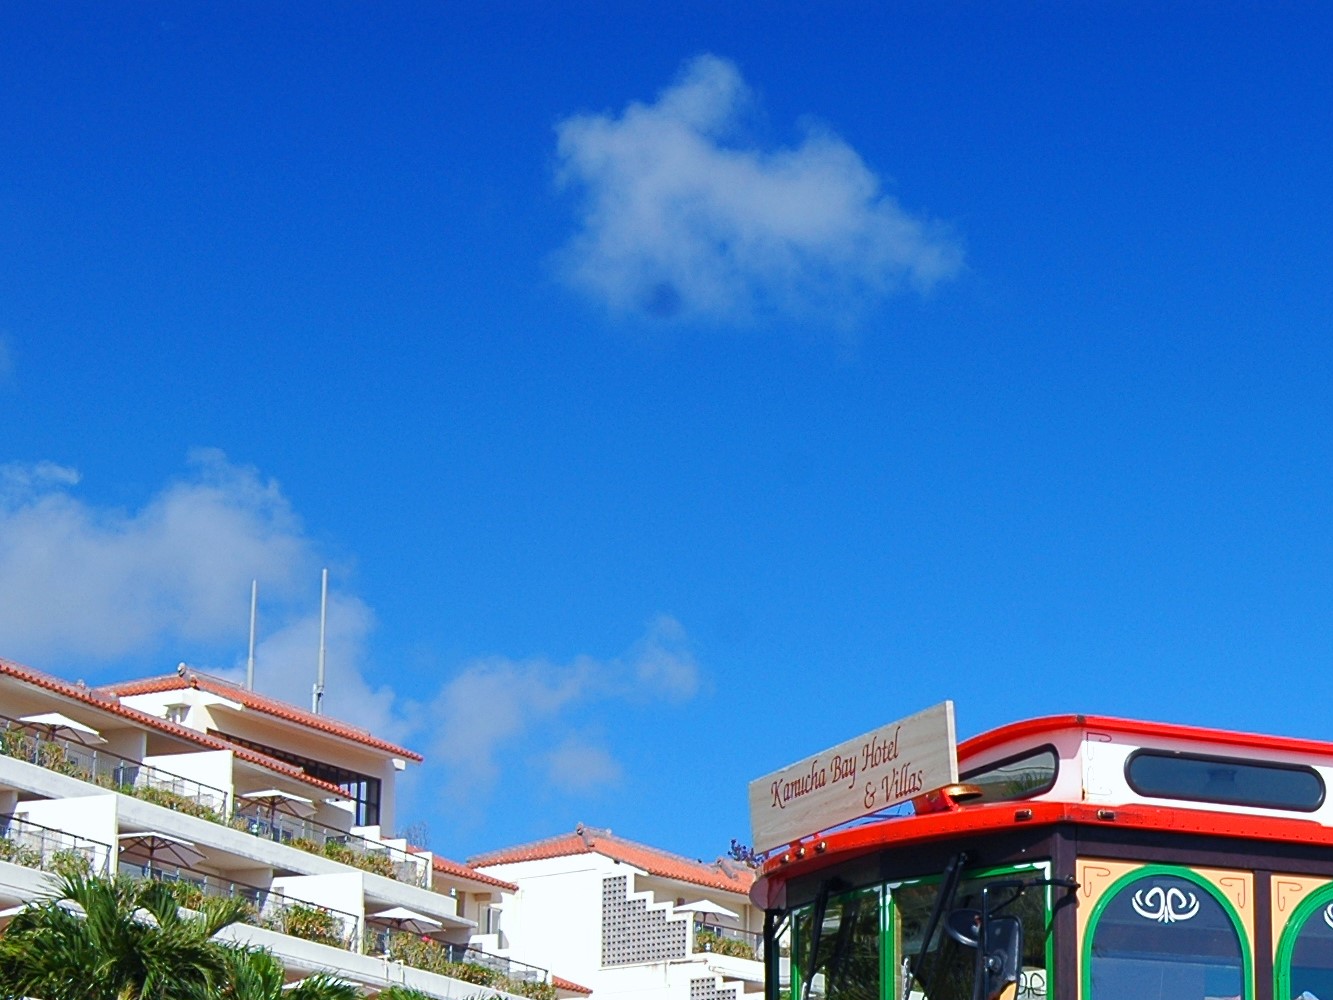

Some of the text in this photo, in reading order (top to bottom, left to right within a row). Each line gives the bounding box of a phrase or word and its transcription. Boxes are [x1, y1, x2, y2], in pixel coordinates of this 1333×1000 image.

[771, 726, 901, 810] Kanucha Bay Hotel
[864, 762, 923, 809] & Villas
